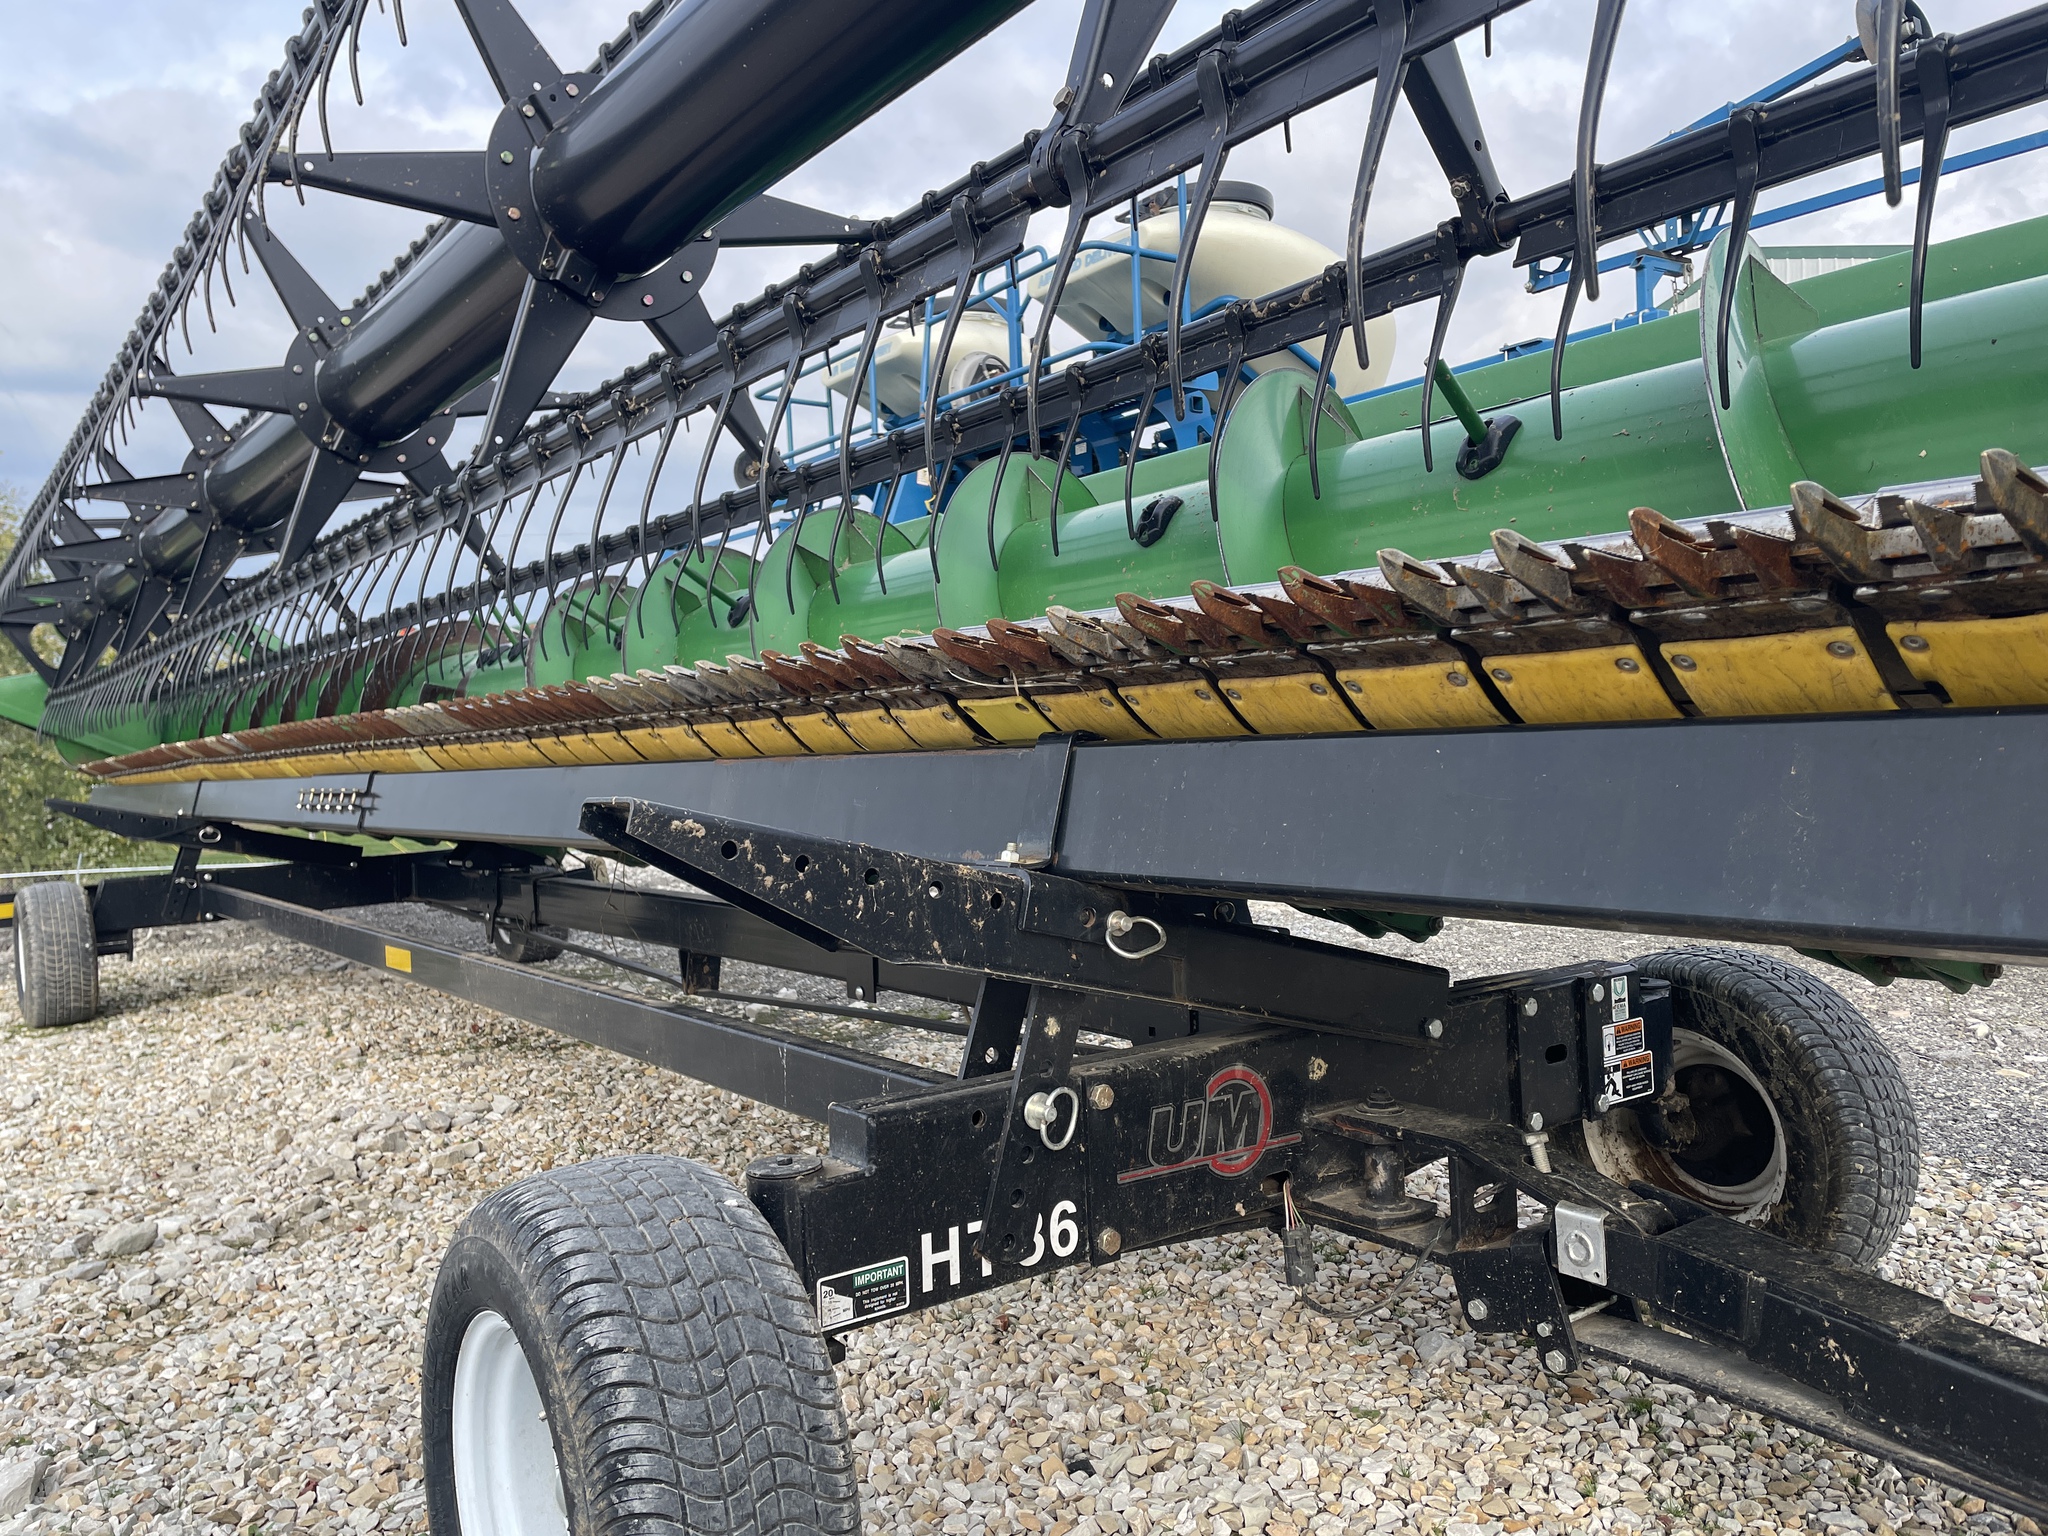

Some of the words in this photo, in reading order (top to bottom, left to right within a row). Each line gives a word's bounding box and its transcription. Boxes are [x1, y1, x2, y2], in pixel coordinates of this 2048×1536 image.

[1621, 1022, 1641, 1033] WARNING
[1628, 1055, 1650, 1067] WARNING
[854, 1264, 904, 1287] IMPORTANT
[823, 1289, 834, 1299] 20
